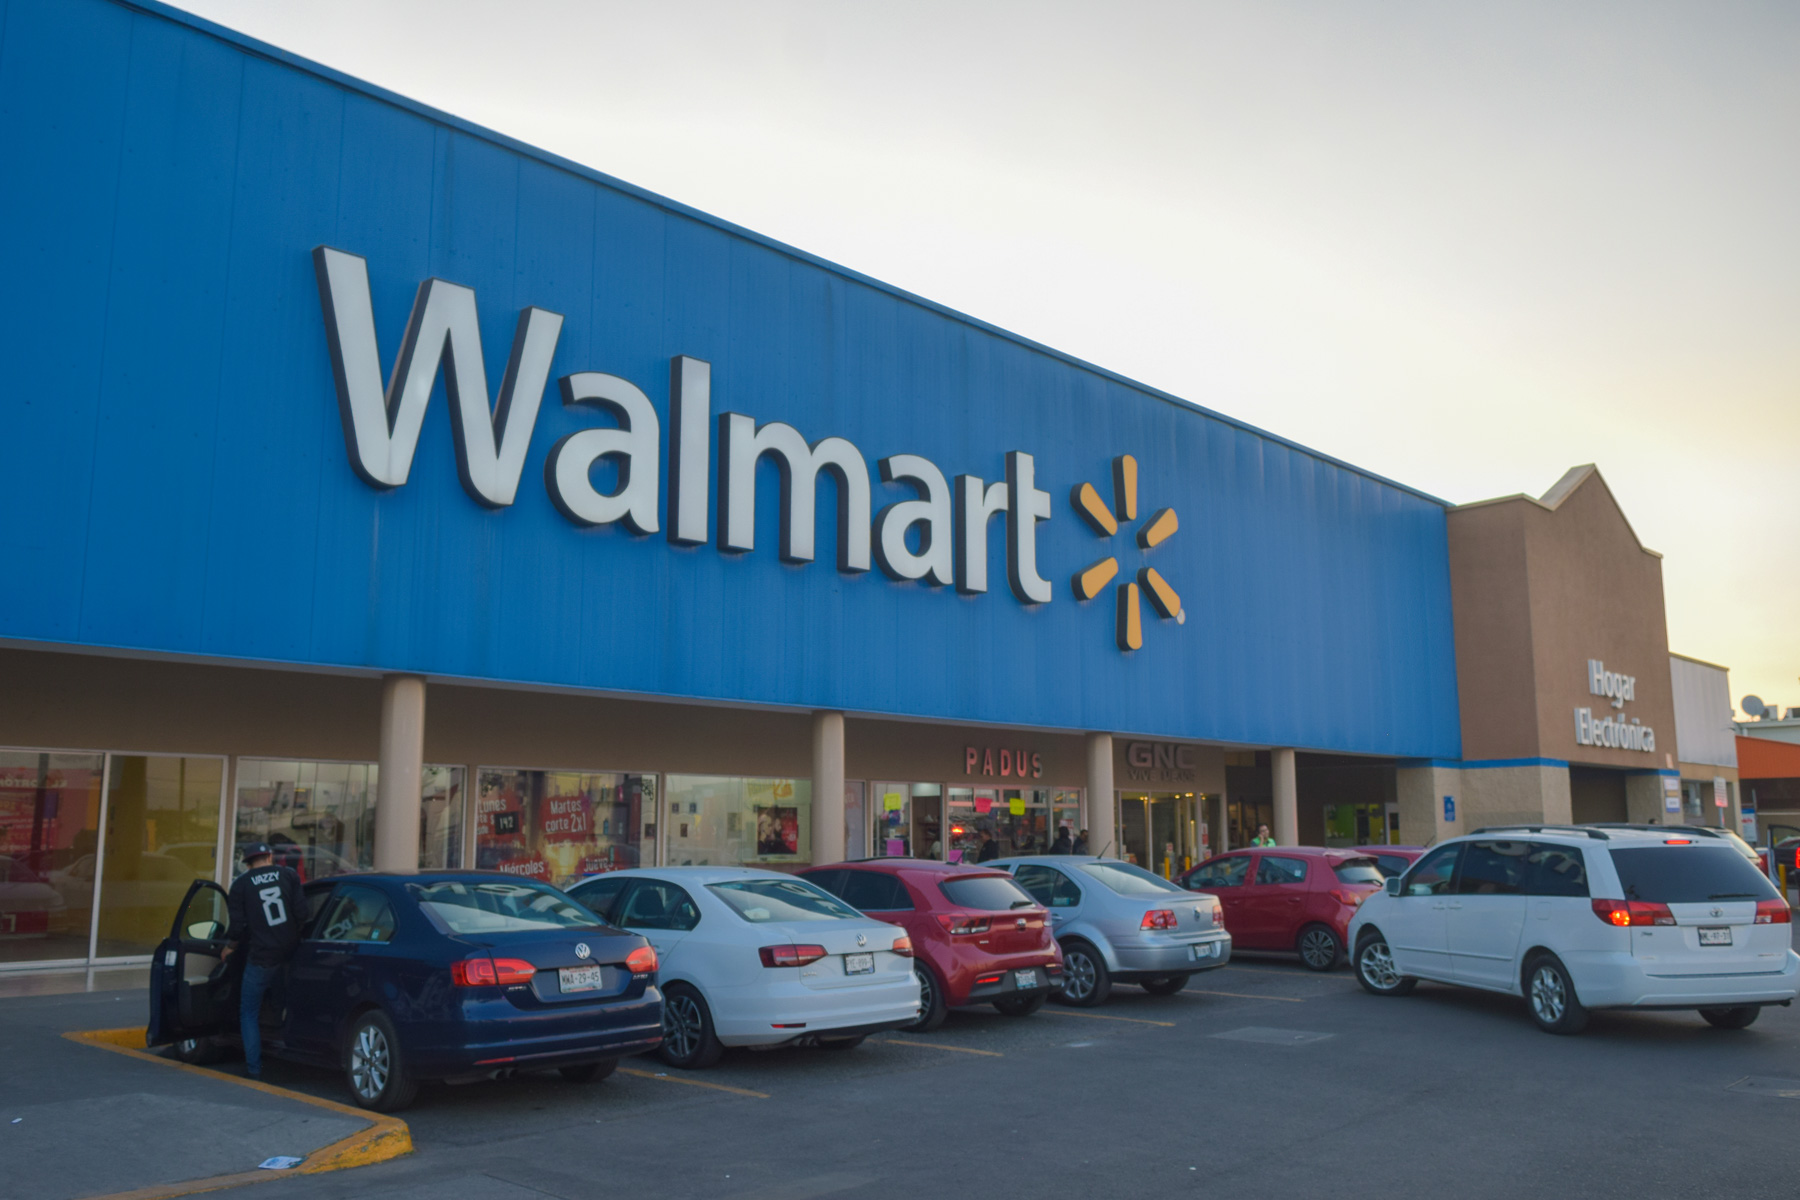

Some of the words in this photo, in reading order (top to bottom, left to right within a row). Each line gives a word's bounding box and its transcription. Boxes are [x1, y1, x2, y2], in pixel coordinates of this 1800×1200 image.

[313, 244, 1053, 604] Walmart
[1588, 659, 1636, 709] Hogar
[1574, 707, 1656, 752] Electrónica
[965, 747, 1043, 779] PADUS
[1126, 741, 1197, 770] GNC
[478, 799, 507, 813] Lunes
[550, 799, 582, 814] Martes
[545, 819, 569, 832] corte
[570, 812, 587, 832] 2x1
[251, 871, 280, 886] VAZZY
[499, 860, 544, 876] Miércoles
[259, 886, 288, 927] 8
